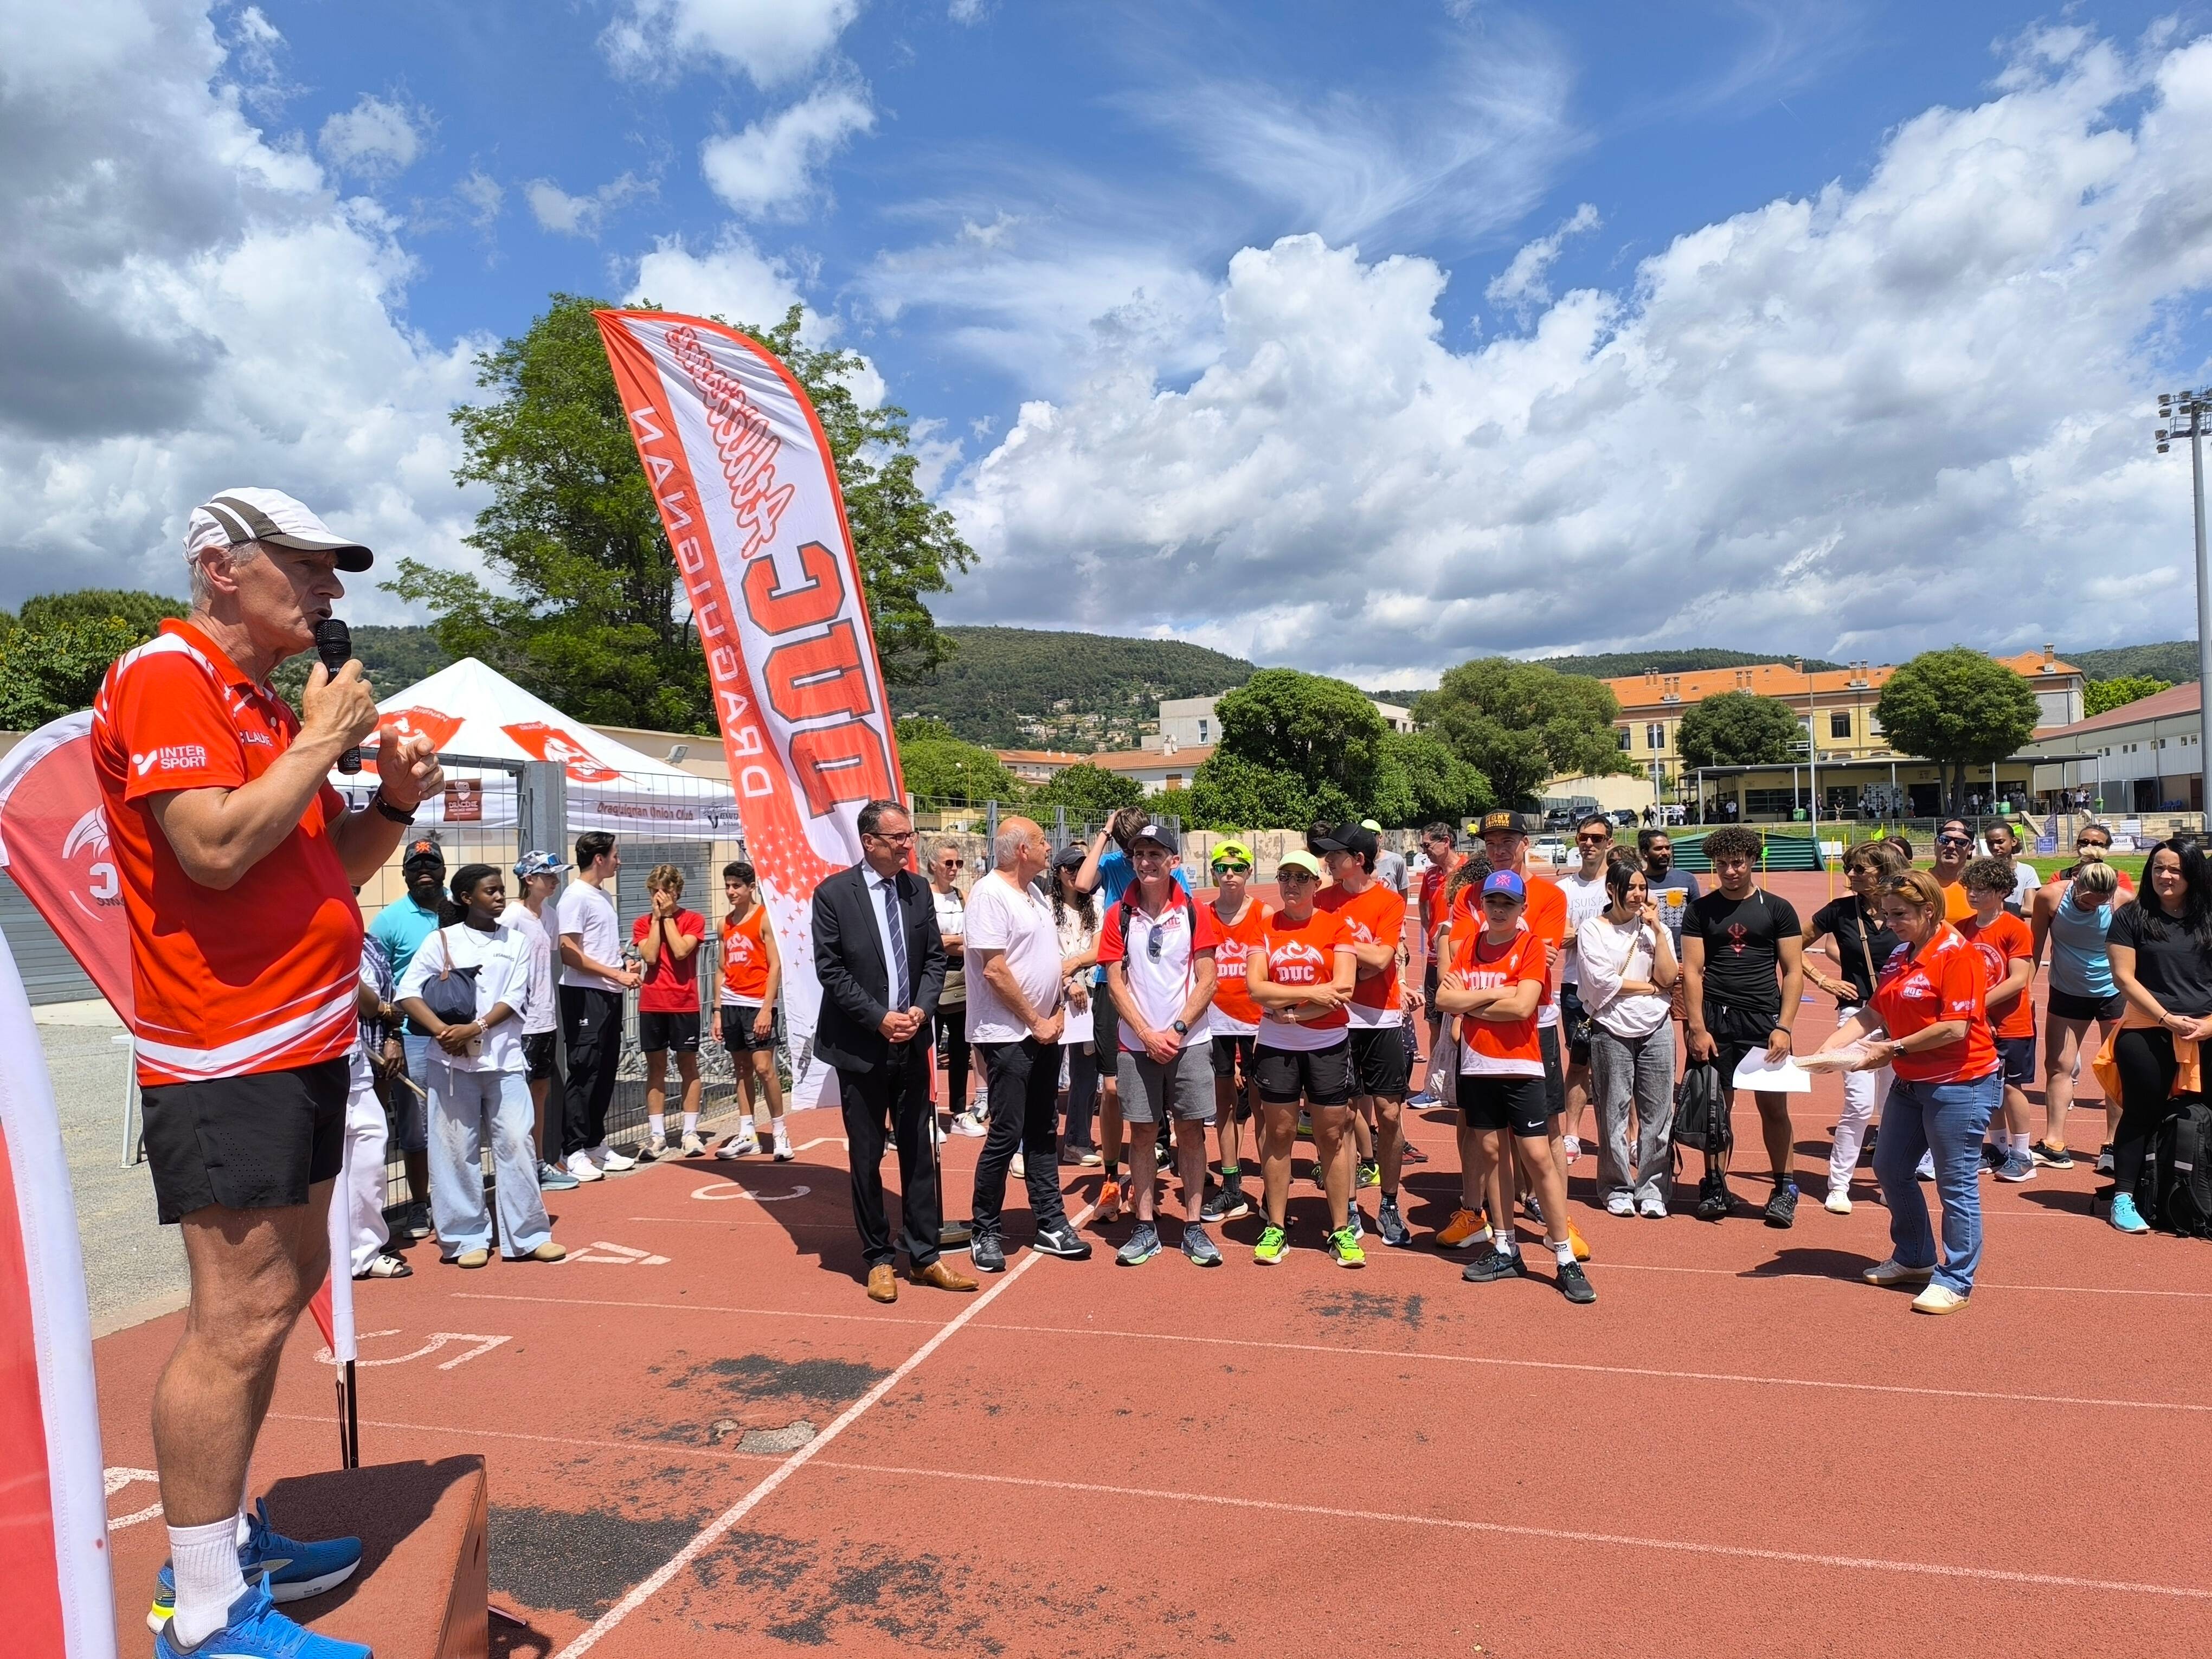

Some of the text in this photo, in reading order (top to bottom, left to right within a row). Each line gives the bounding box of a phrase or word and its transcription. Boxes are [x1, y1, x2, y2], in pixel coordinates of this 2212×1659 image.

[159, 746, 206, 758] INTER
[160, 756, 207, 769] SPORT
[597, 802, 694, 820] Draguignan Union Club
[1486, 814, 1510, 822] MONT
[1598, 896, 1609, 905] PA
[1217, 962, 1246, 978] DUC
[1276, 965, 1315, 981] DUC
